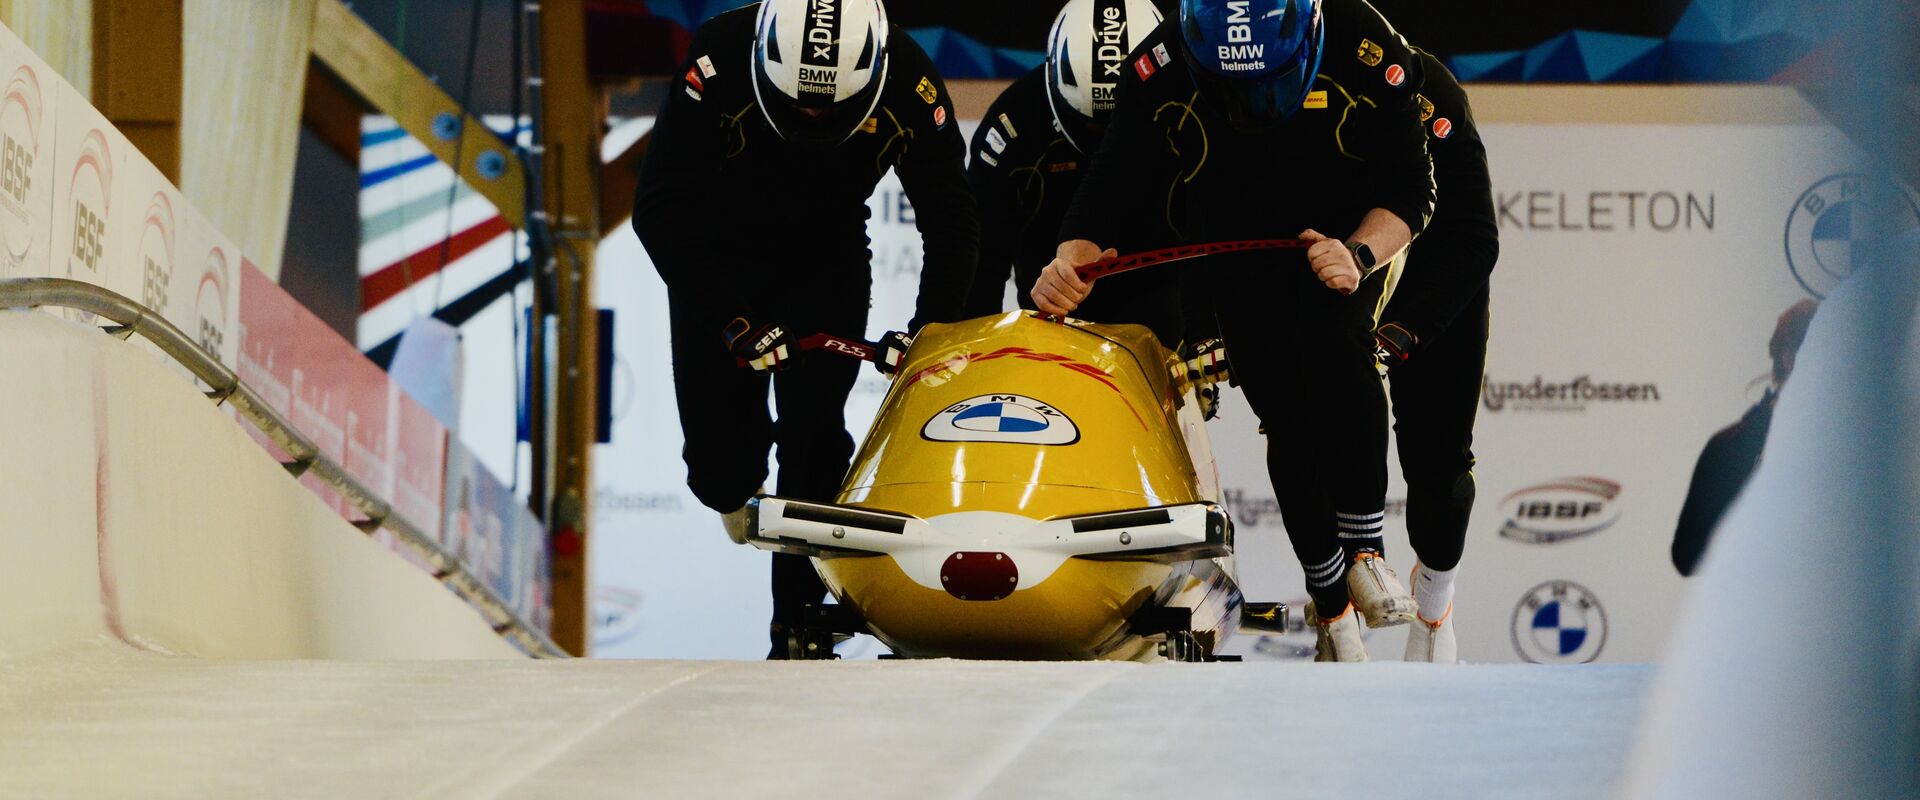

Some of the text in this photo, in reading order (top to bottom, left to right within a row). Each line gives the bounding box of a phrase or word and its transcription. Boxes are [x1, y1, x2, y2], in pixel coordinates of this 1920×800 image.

[808, 0, 835, 60] xDriv
[1227, 0, 1251, 42] BM
[1098, 6, 1120, 76] xDrive
[1218, 44, 1264, 60] BMW
[799, 68, 837, 83] BMW
[1221, 61, 1265, 71] helmets
[799, 83, 836, 94] helmets
[1092, 87, 1116, 99] BM
[1092, 102, 1116, 111] helm
[0, 133, 33, 204] IBSF
[1498, 192, 1714, 230] KELETON
[73, 200, 105, 273] IBSF
[755, 326, 784, 354] SEIZ
[895, 333, 913, 347] SE
[945, 395, 1061, 417] BMW
[1518, 501, 1603, 519] IBSF
